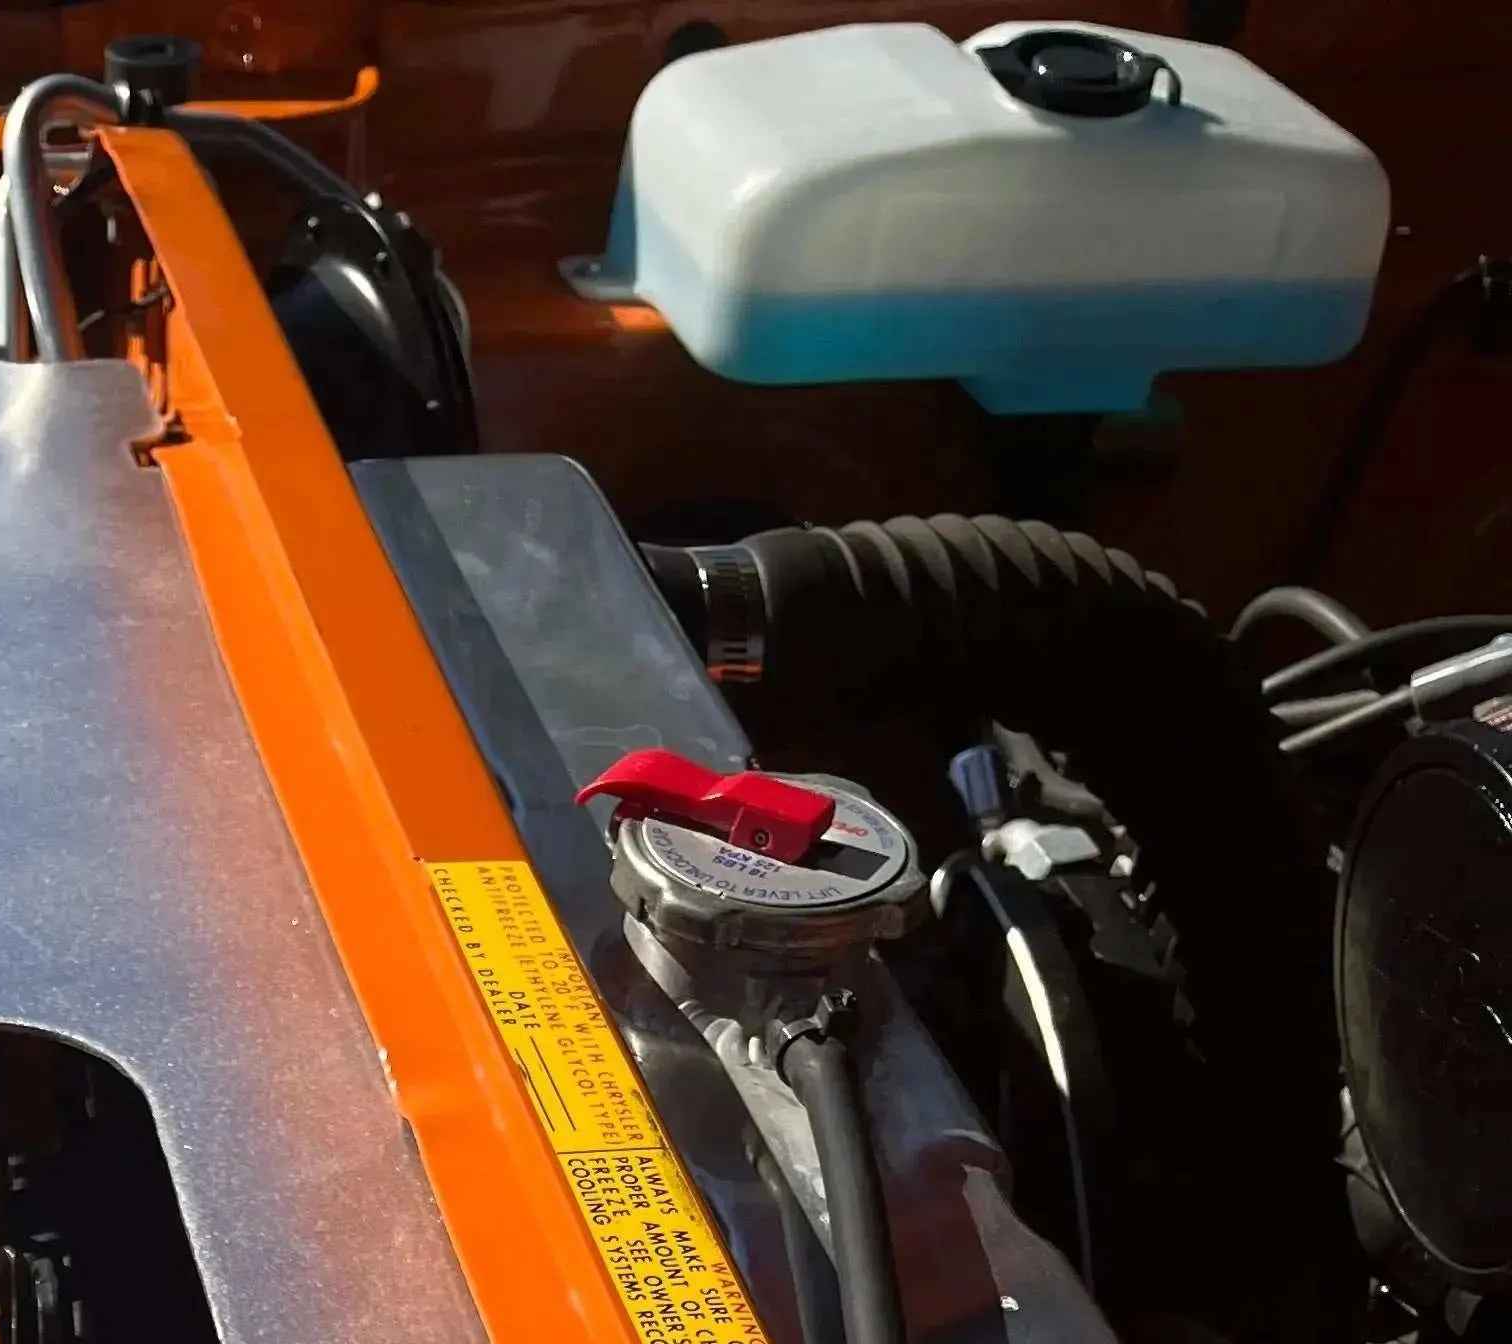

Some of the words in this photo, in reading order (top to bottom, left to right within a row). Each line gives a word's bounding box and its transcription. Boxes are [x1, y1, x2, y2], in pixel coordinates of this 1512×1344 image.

[434, 868, 473, 933] CHECKED
[466, 942, 488, 959] BY
[478, 969, 516, 1025] DEALER
[715, 881, 737, 892] TO
[743, 887, 800, 901] LEVER
[476, 867, 527, 949] ANTIFREEZE
[557, 1037, 598, 1097] GLYCOL
[498, 867, 548, 944] PROTECTED
[539, 951, 560, 970] TO
[573, 1023, 606, 1062] WITH
[598, 1072, 644, 1142] CHRYSLER
[508, 991, 541, 1030] DATE
[558, 948, 609, 1031] IMPORTANT
[568, 1158, 611, 1226] COOLING
[600, 1235, 646, 1302] SYSTEMS
[611, 1156, 650, 1209] PROPER
[643, 1221, 688, 1288] AMOUNT
[681, 1300, 704, 1320] OF
[626, 1240, 652, 1264] SEE
[635, 1156, 678, 1216] ALWAYS
[672, 1230, 706, 1273] MAKE
[700, 1288, 732, 1324] SURE
